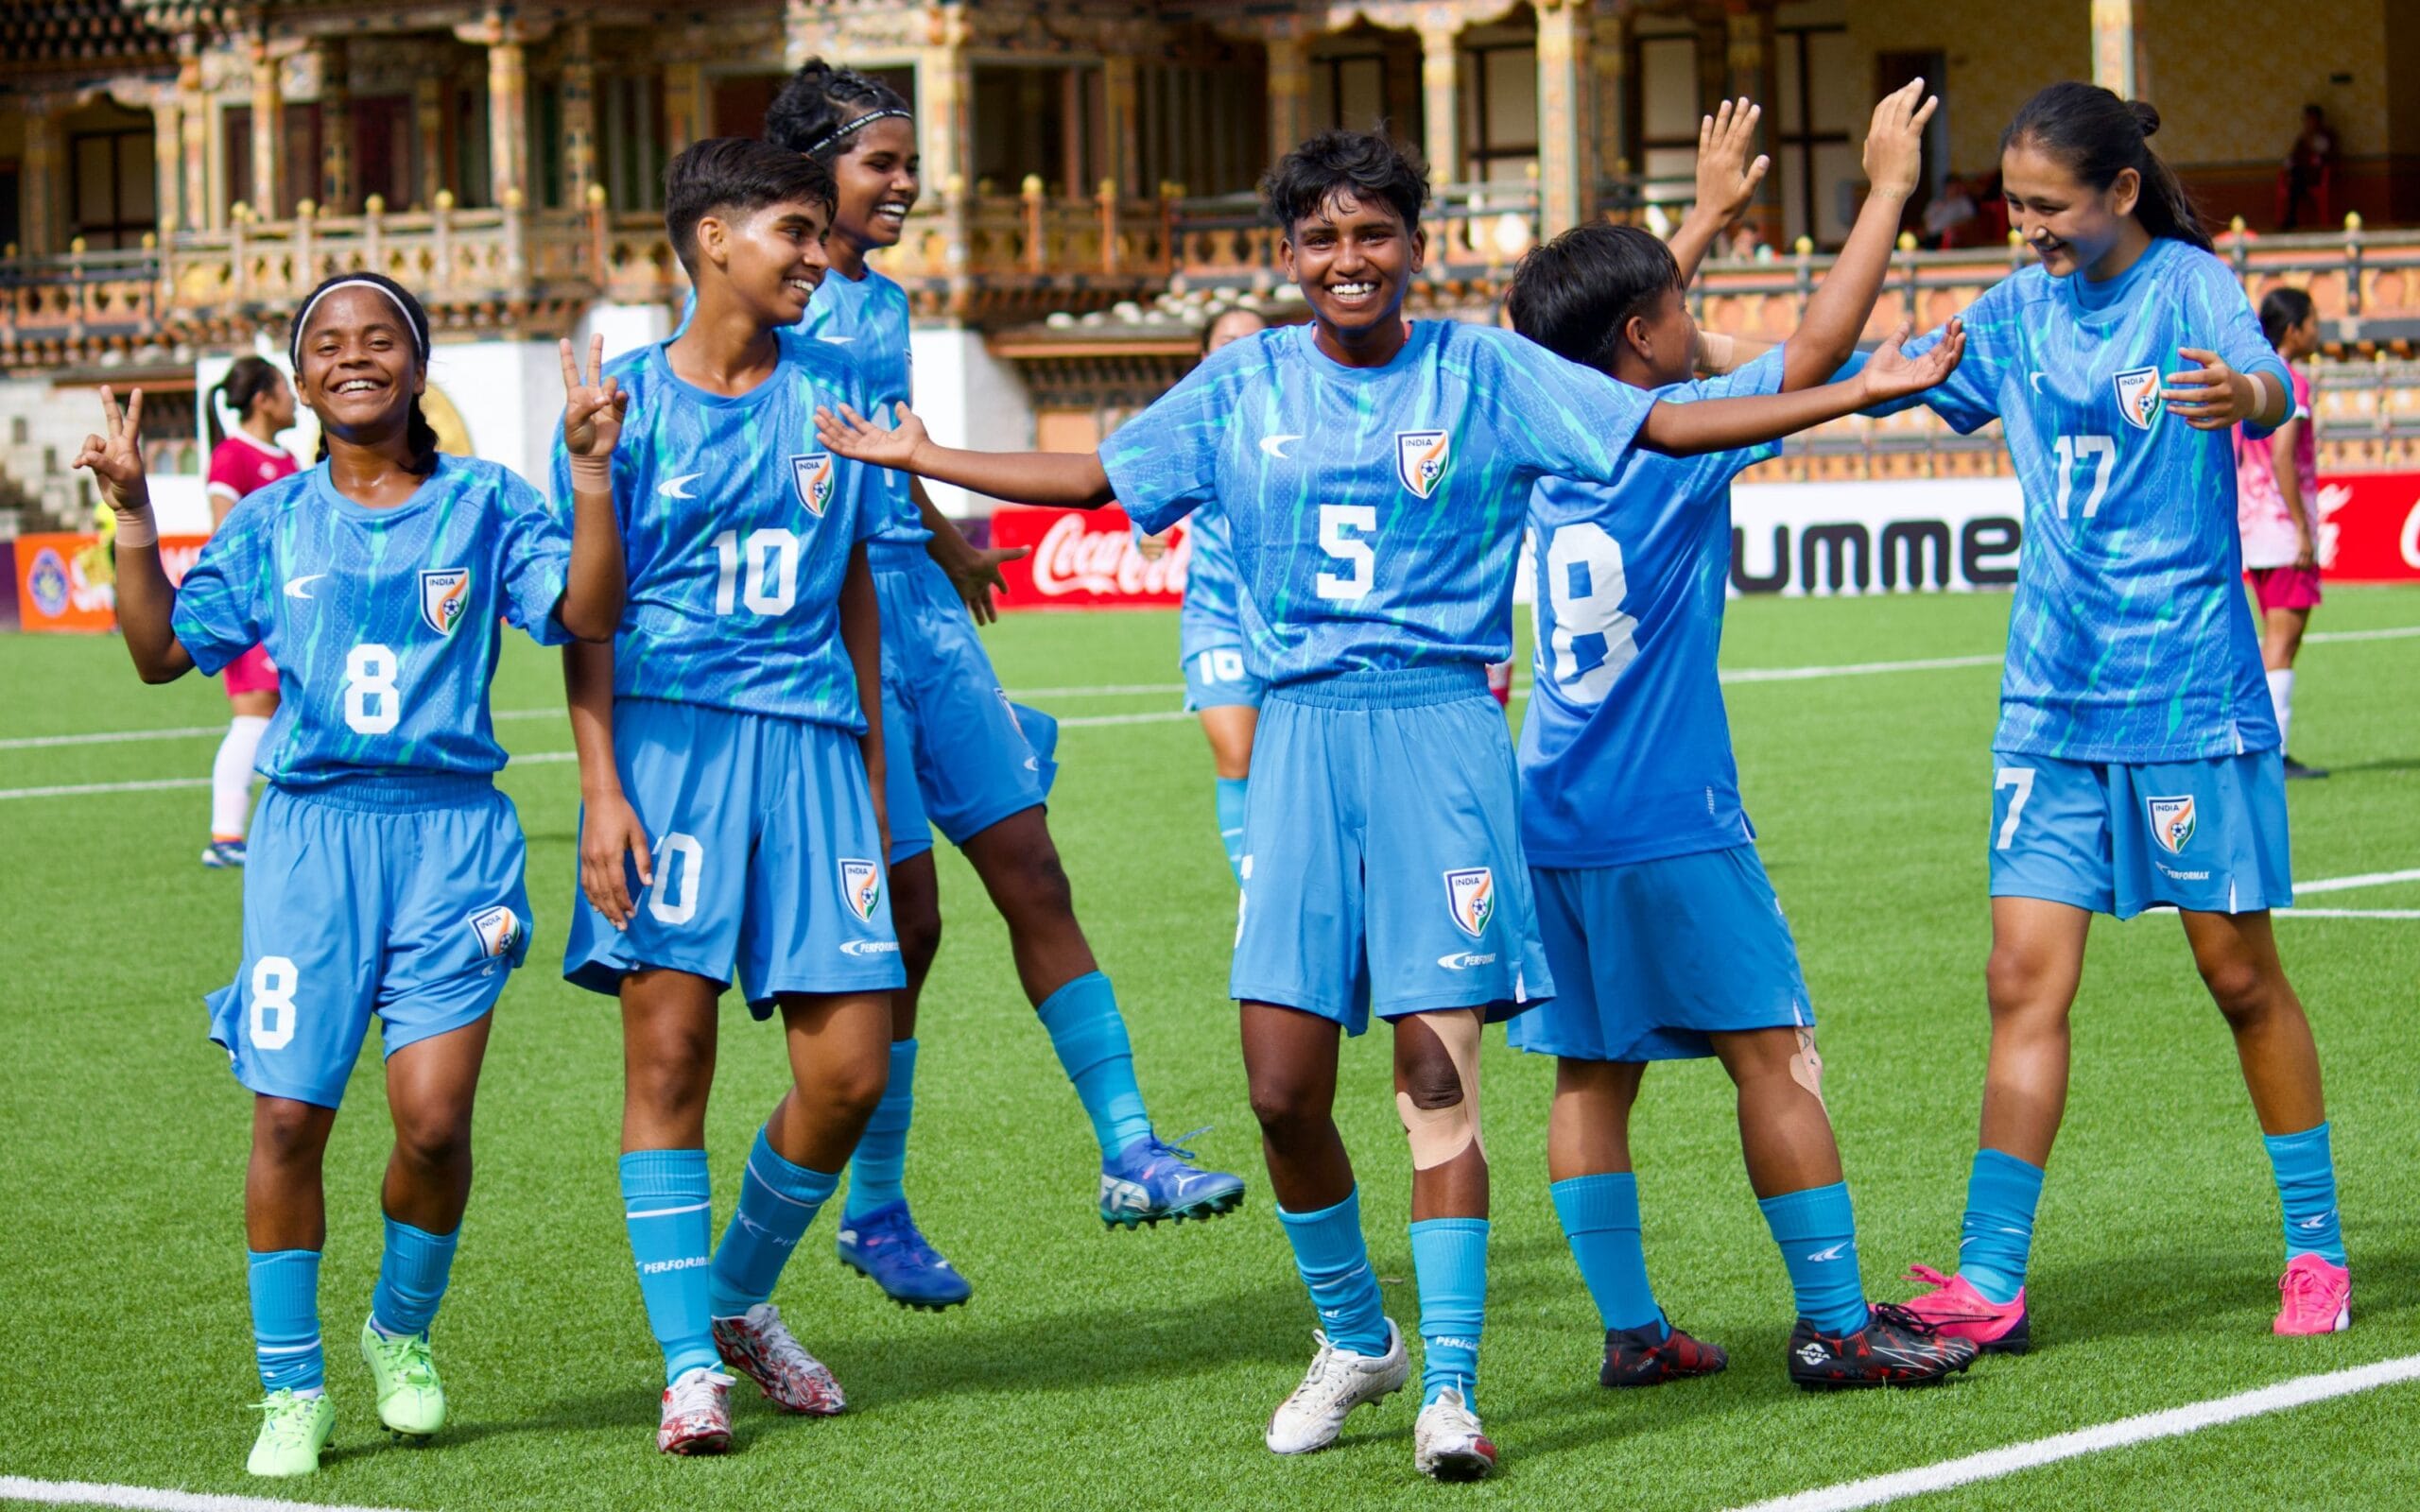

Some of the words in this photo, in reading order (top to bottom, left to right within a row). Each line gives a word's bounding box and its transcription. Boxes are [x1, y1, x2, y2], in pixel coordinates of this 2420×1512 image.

[2121, 376, 2146, 387] INDIA
[1405, 438, 1433, 447] INDIA
[798, 461, 821, 471] INDIA
[2053, 435, 2117, 521] 17
[1317, 504, 1376, 600] 5
[1731, 517, 2022, 593] umme
[710, 527, 799, 616] 10
[428, 577, 456, 587] INDIA
[345, 644, 400, 734] 8
[2155, 803, 2180, 813] INDIA
[645, 832, 703, 924] 0
[847, 867, 869, 876] INDIA
[1455, 876, 1480, 886] INDIA
[480, 914, 502, 929] INDIA
[250, 955, 299, 1050] 8
[1796, 1349, 1831, 1360] NIVIA
